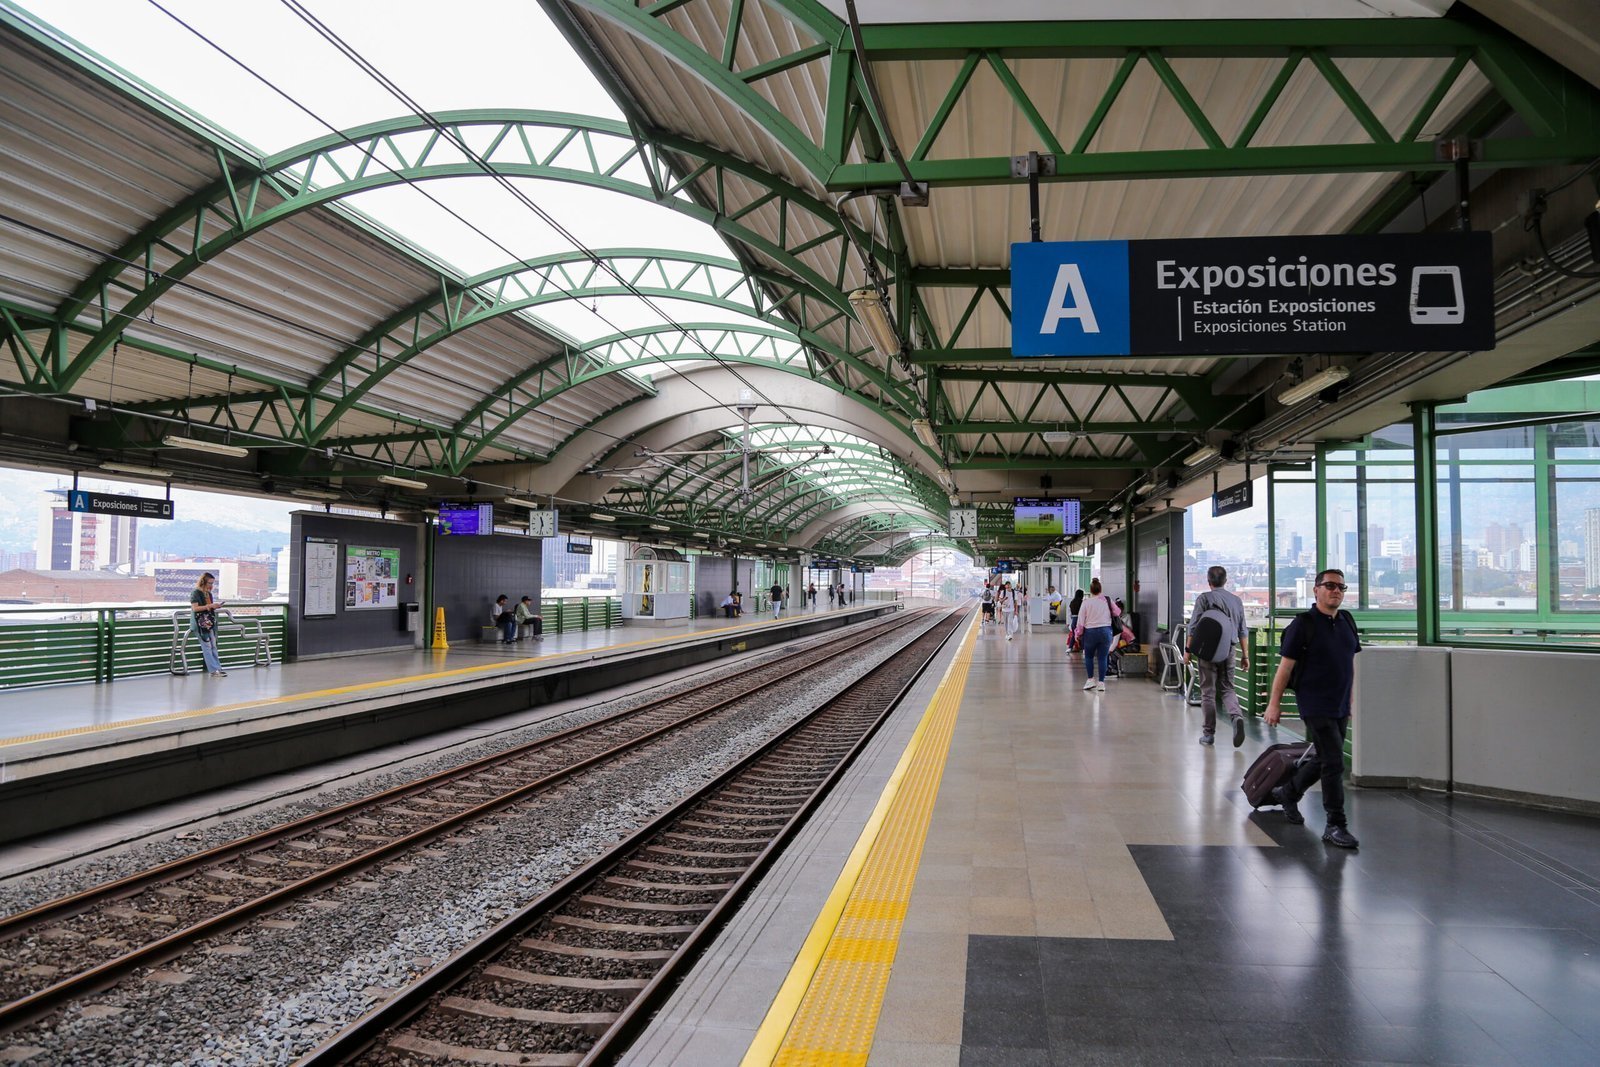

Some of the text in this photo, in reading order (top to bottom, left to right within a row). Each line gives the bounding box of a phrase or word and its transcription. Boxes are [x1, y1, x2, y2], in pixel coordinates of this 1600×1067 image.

[1156, 256, 1397, 296] Exposiciones
[1039, 263, 1100, 334] A
[1193, 299, 1376, 316] Estación Exposiciones
[1194, 318, 1346, 336] Exposiciones Station
[75, 494, 138, 511] A Exposiciones
